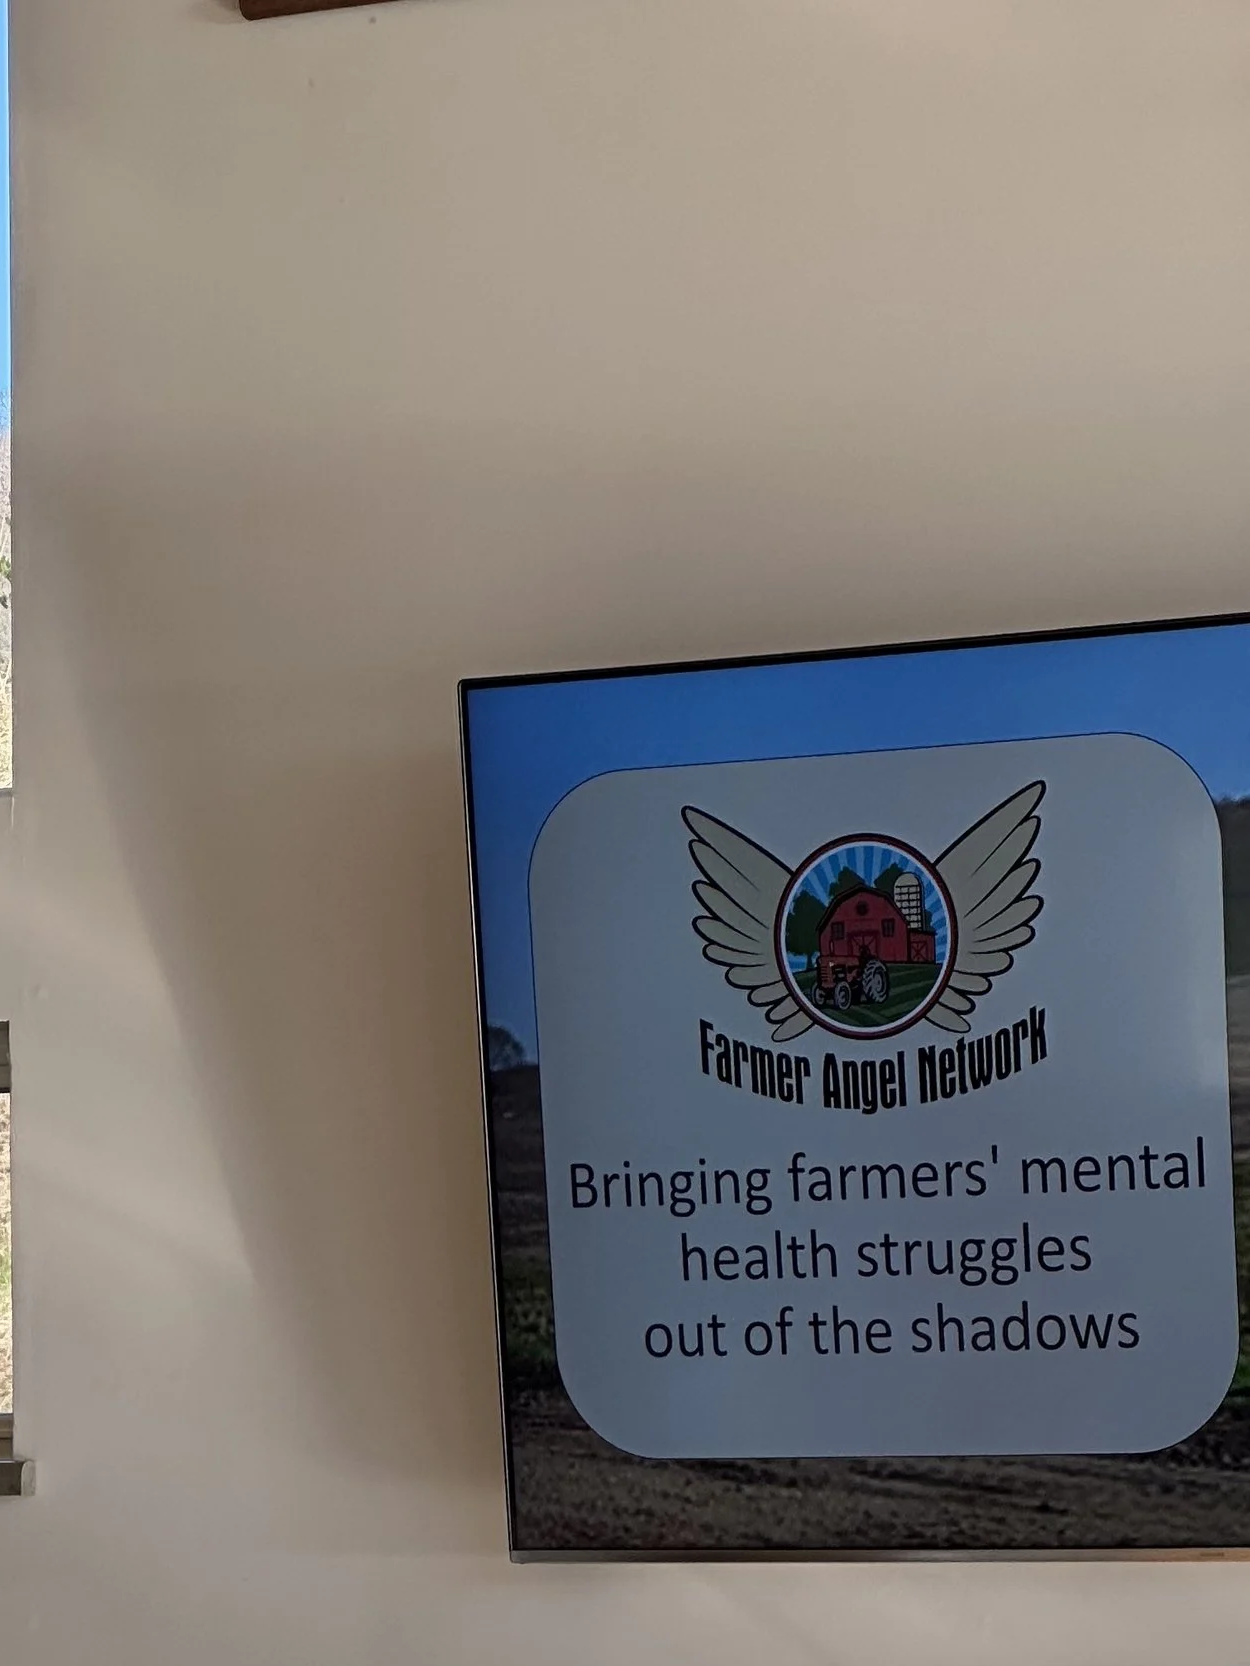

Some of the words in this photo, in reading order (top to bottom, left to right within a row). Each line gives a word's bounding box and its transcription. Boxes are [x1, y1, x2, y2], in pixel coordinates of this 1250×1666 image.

[699, 1018, 811, 1105] Farmer
[822, 1050, 907, 1114] Angel
[918, 1005, 1048, 1103] Network
[569, 1158, 773, 1217] Bringing
[787, 1144, 999, 1202] farmers'
[1021, 1136, 1206, 1195] mental
[681, 1228, 839, 1282] health
[857, 1222, 1092, 1287] struggles
[644, 1312, 727, 1358] out
[744, 1305, 793, 1356] of
[809, 1305, 892, 1354] the
[911, 1301, 1140, 1354] shadows
